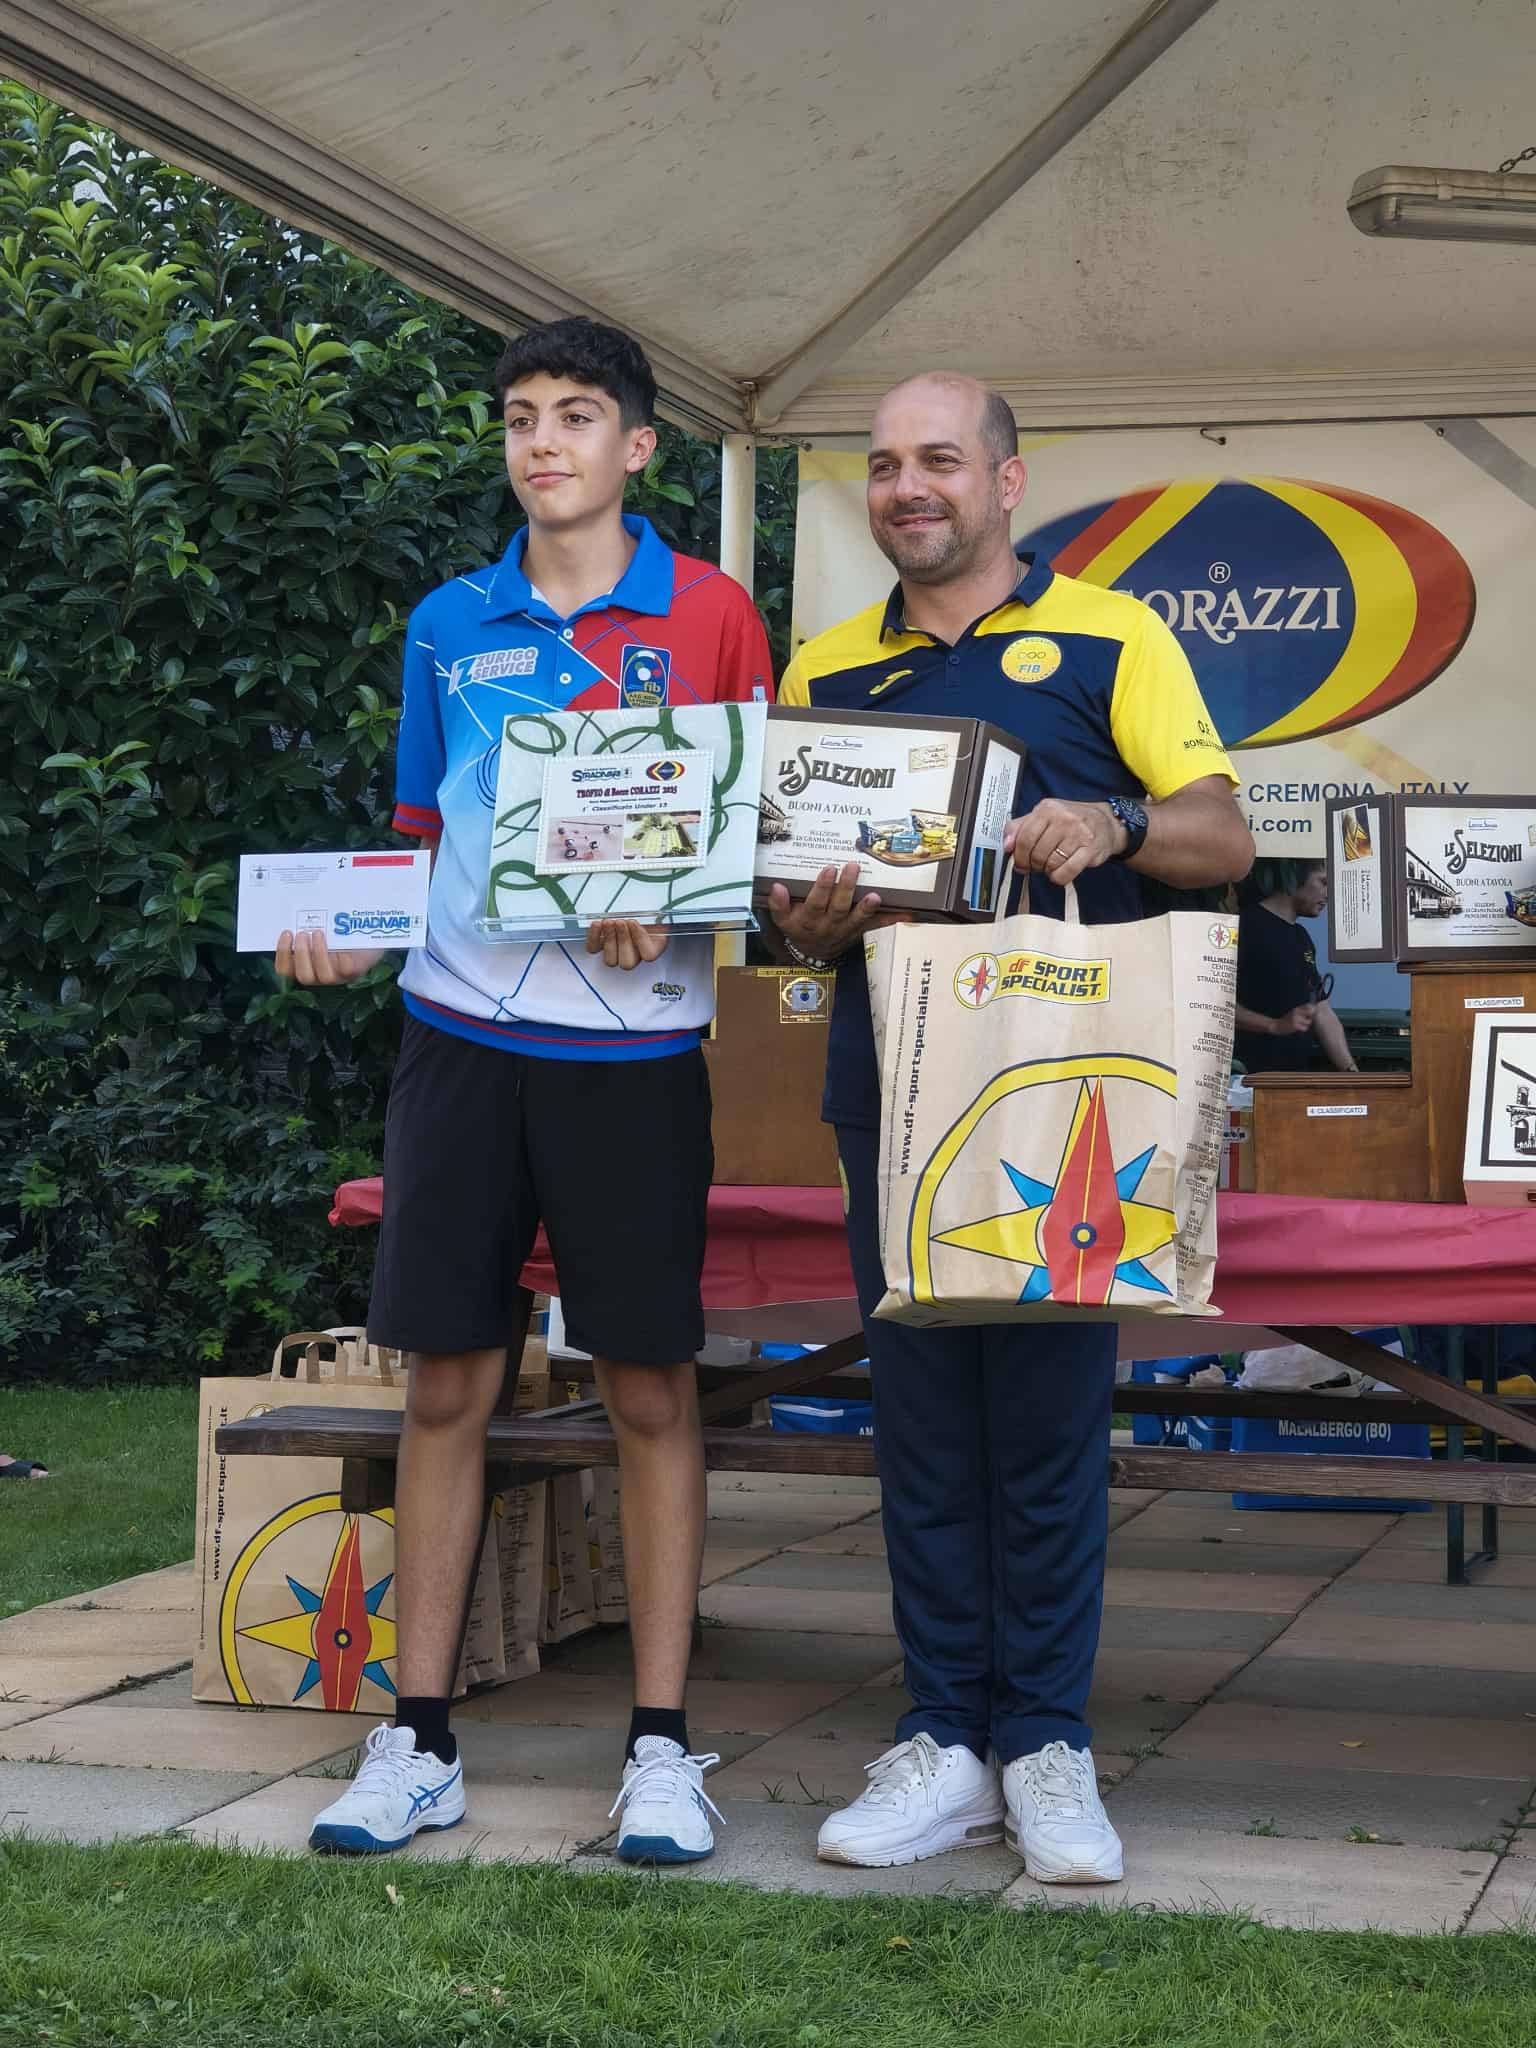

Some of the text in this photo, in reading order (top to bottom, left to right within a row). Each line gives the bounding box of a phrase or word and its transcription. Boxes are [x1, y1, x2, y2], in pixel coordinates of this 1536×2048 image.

[1112, 586, 1342, 644] ORAZZI
[476, 649, 536, 667] ZURIGO
[1019, 664, 1041, 673] FIB
[474, 661, 534, 679] SERVICE
[778, 760, 796, 776] LE
[779, 746, 896, 797] SELEZIONI
[1248, 782, 1375, 802] CREMONA
[788, 801, 872, 816] BUONI A TAVOLA
[1444, 829, 1522, 875] LE SELEZIONI
[1486, 878, 1513, 887] TAVOLA
[334, 912, 411, 936] STRADIVARI
[1034, 960, 1103, 982] SPORT
[900, 959, 932, 1176] www.df-sportspecialist.it
[1366, 1421, 1392, 1443] (BO)
[213, 1407, 228, 1581] www.df-sportspect.it
